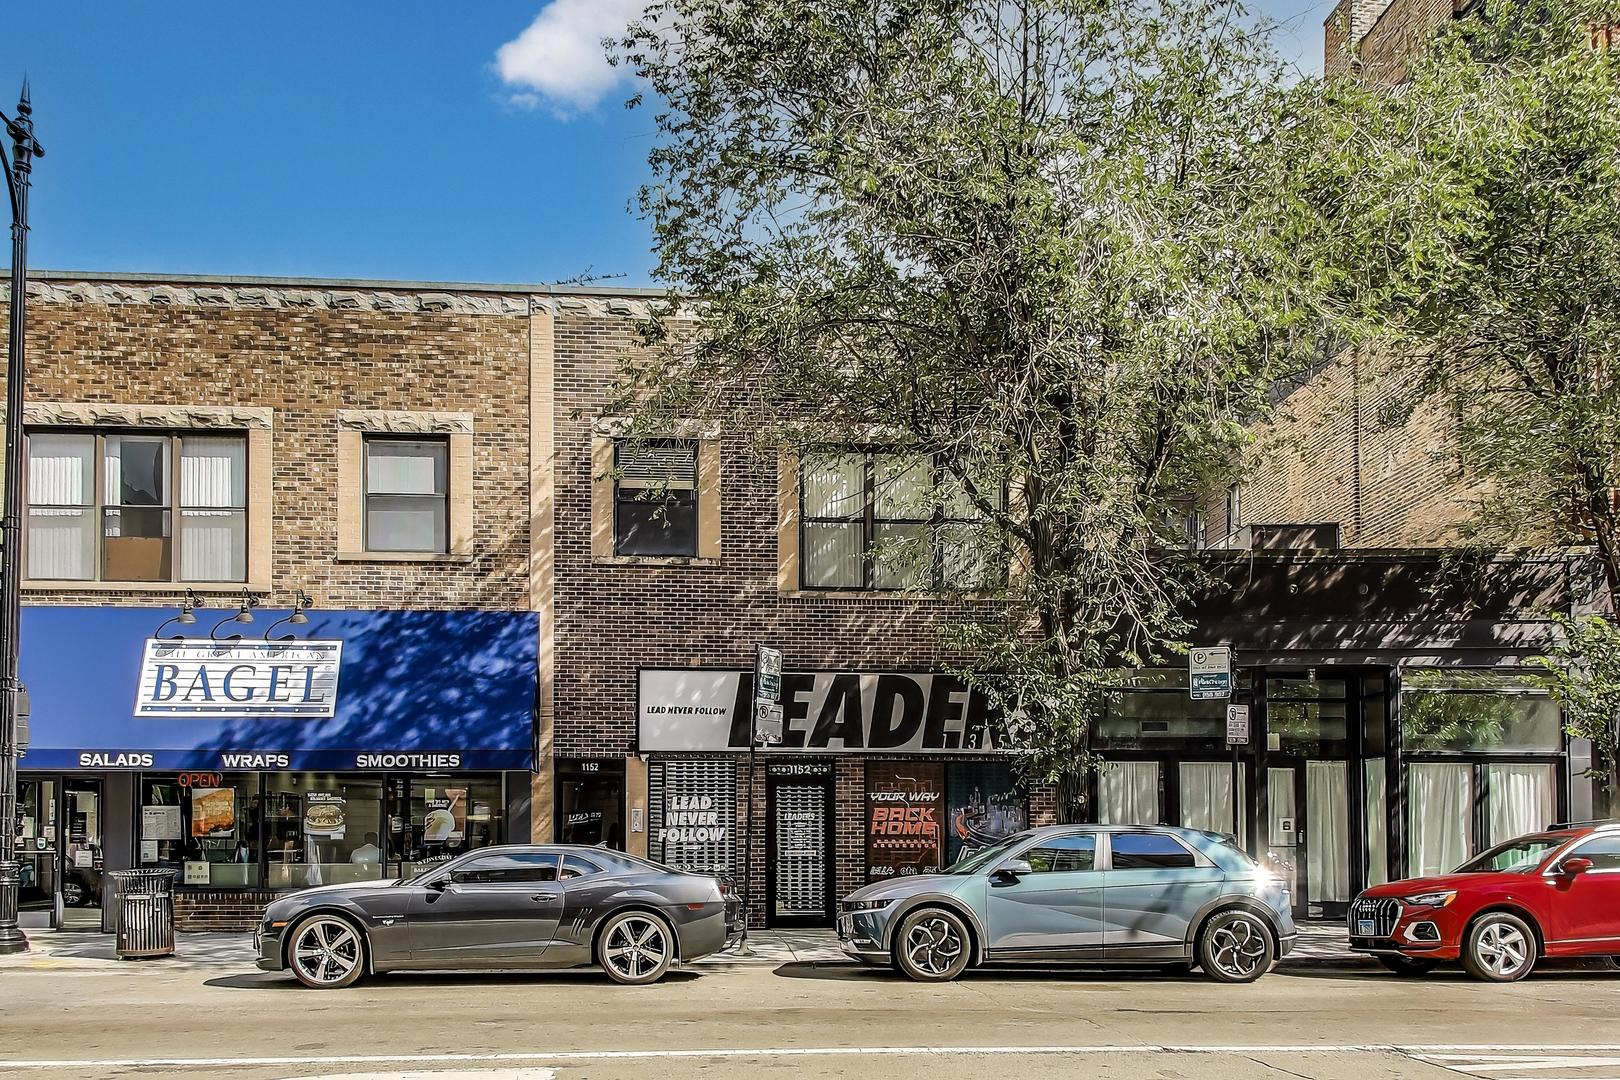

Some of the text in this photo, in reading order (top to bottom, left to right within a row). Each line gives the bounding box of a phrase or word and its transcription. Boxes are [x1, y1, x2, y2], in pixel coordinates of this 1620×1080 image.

[150, 664, 325, 703] BAGEL
[646, 706, 727, 716] LEAD NEVER FOLLOW
[727, 672, 1058, 749] LEADER
[79, 753, 460, 768] SALADS WRAPS SMOOTHIES
[582, 762, 599, 772] 1152
[790, 764, 811, 774] 1152
[178, 773, 220, 787] OPEN
[671, 796, 712, 810] LEAD
[867, 792, 941, 801] YOUR WAY
[666, 812, 718, 826] NEVER
[784, 812, 816, 820] LEADERS
[872, 807, 936, 821] BACK
[658, 828, 725, 842] FOLLOW
[870, 821, 937, 835] HOME
